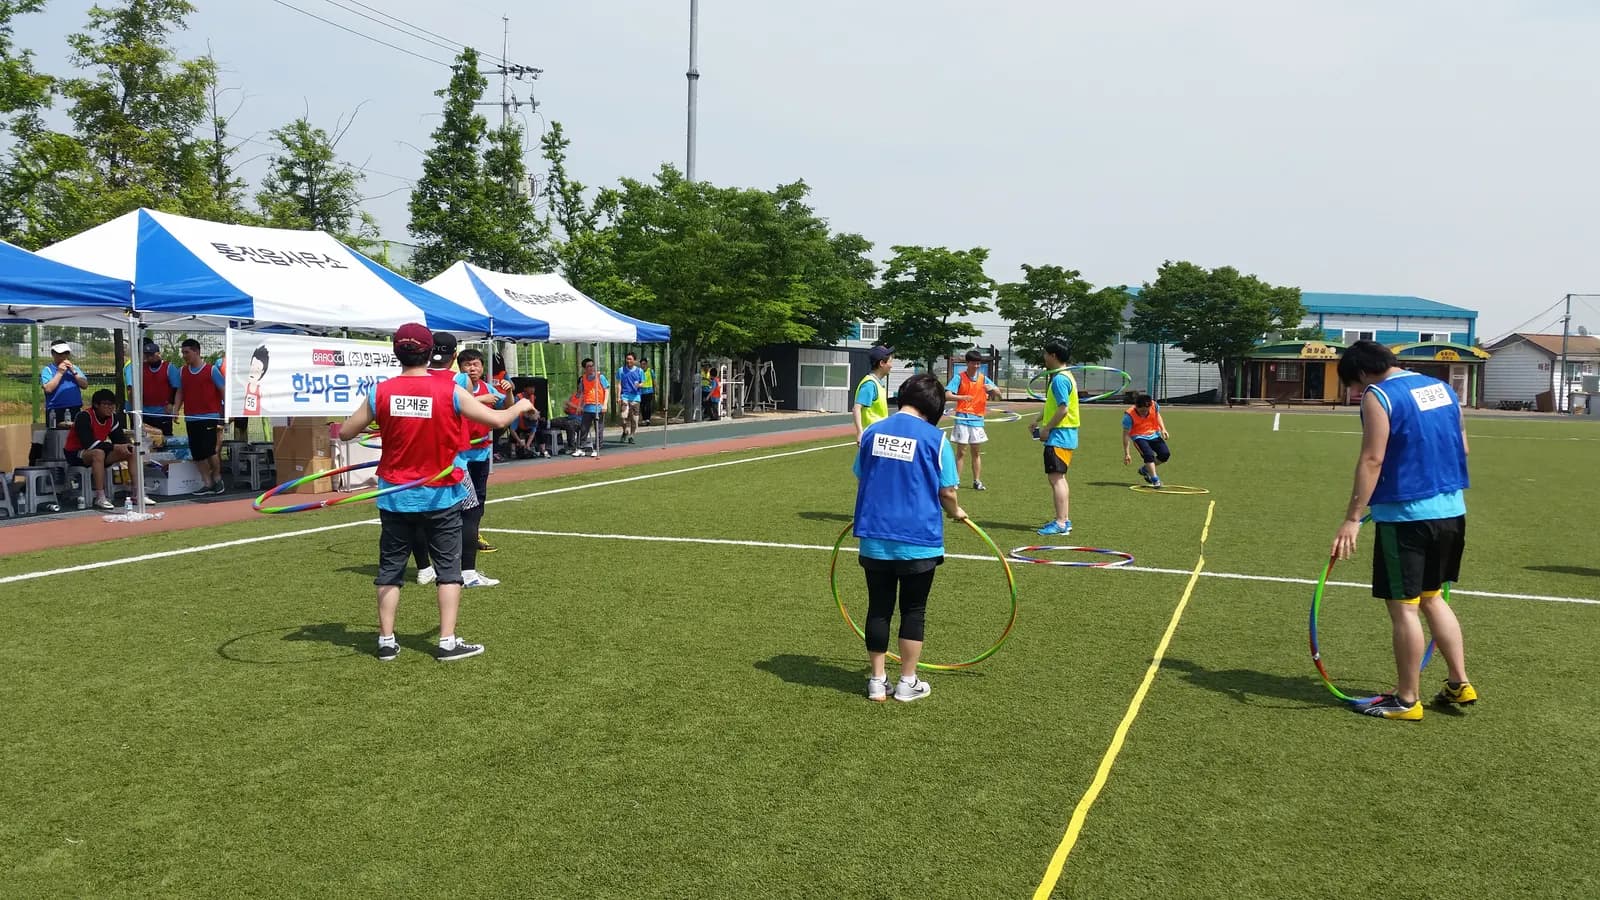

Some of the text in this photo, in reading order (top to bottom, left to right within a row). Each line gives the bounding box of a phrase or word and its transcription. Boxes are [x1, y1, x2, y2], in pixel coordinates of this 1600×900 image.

[210, 242, 349, 270] 통진읍사무소
[348, 351, 402, 368] (주)한국바로
[291, 372, 388, 404] 한마음 체
[247, 396, 256, 408] 56
[394, 397, 430, 412] 임재윤
[877, 436, 913, 455] 박은선
